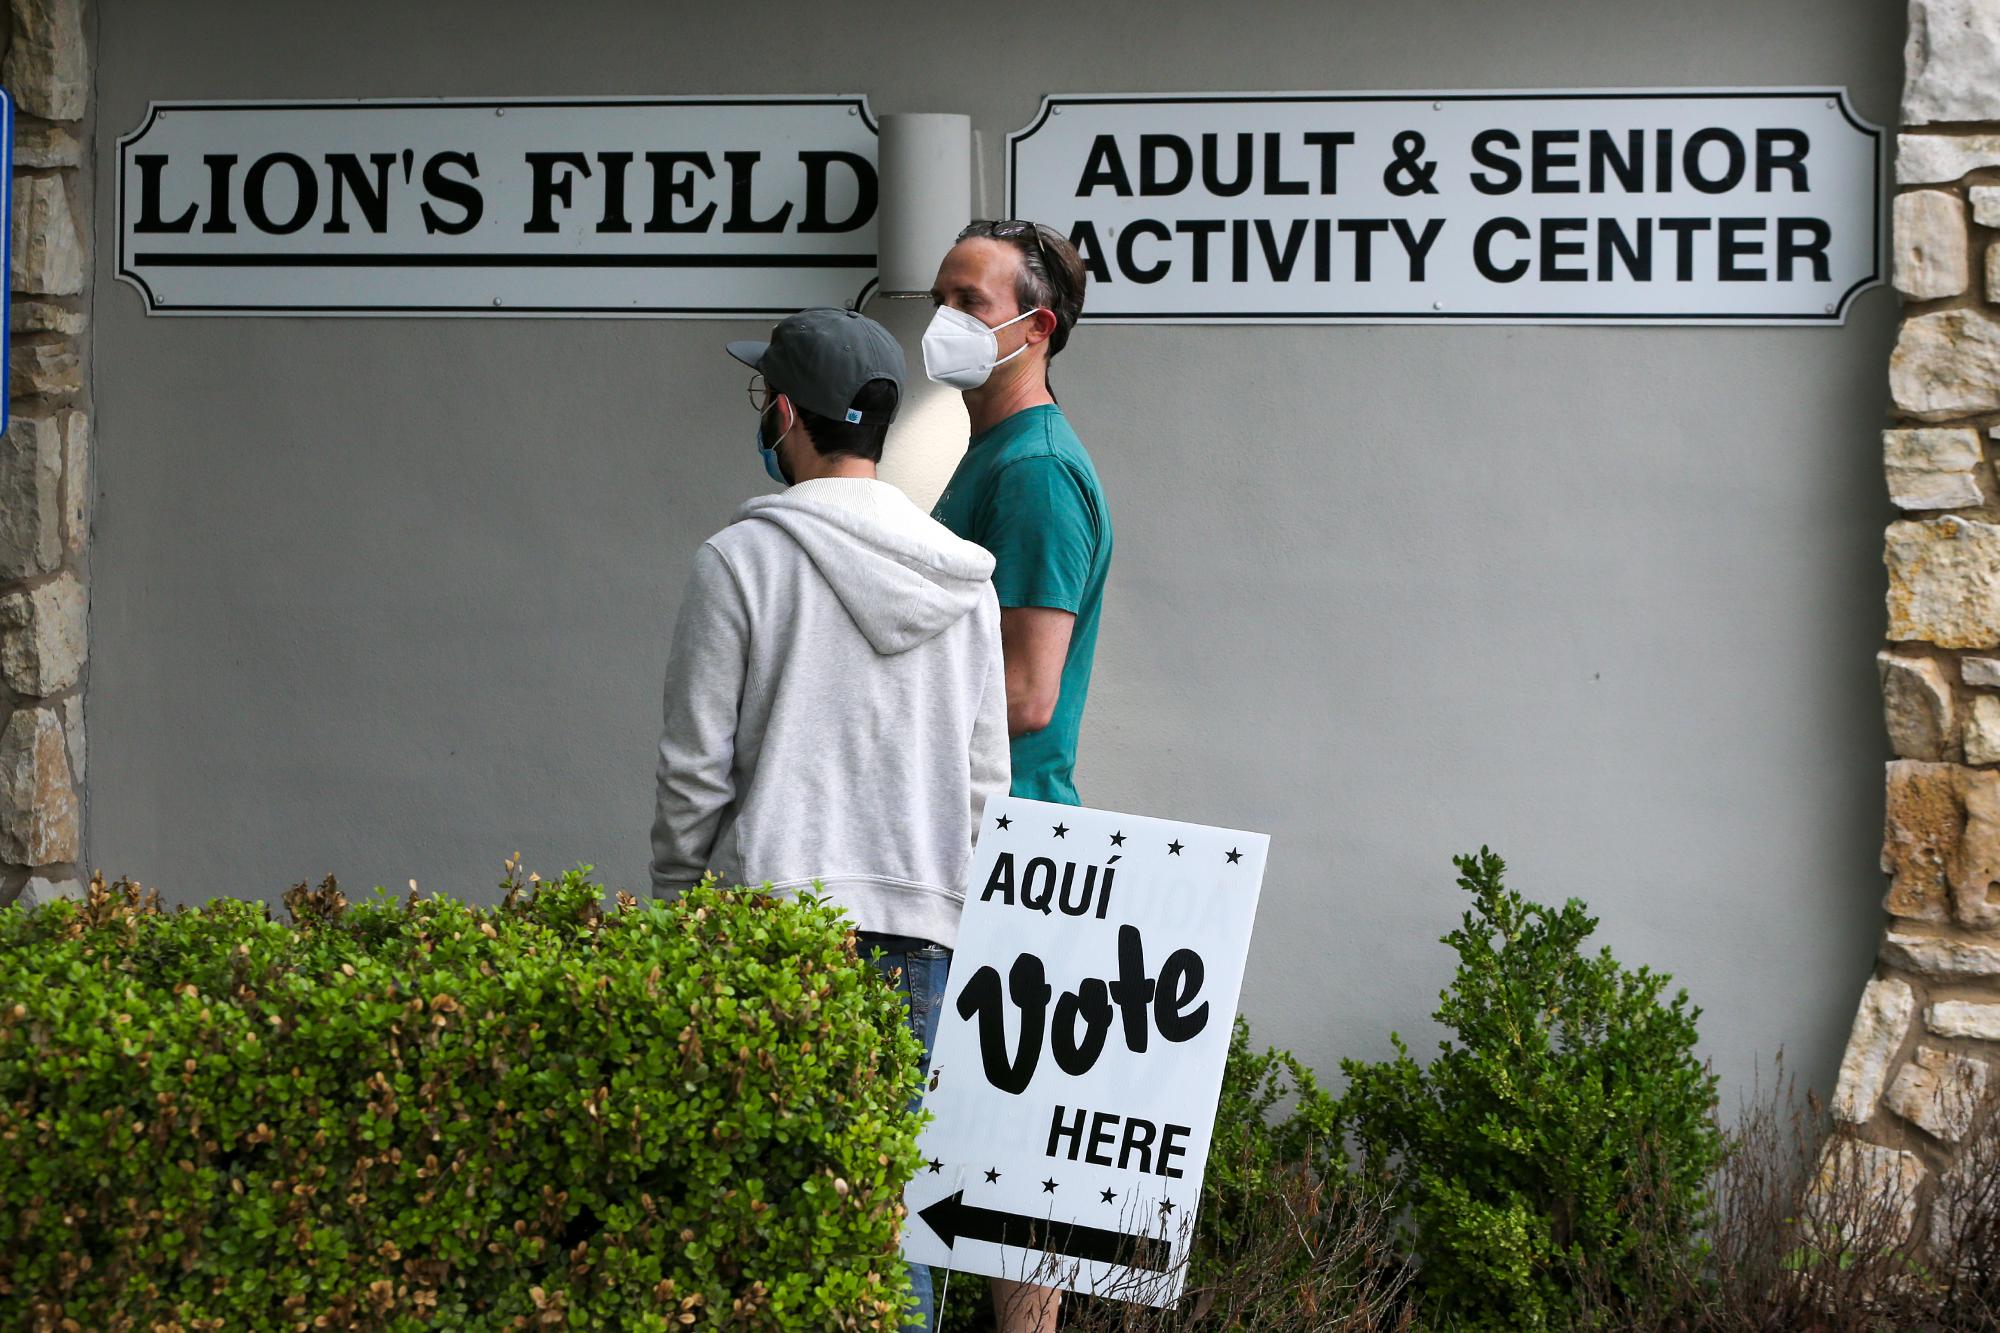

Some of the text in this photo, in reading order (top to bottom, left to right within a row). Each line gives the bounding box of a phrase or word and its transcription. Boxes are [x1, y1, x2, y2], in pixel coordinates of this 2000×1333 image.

[133, 148, 879, 235] LION'S FIELD
[1074, 127, 1811, 198] ADULT & SENIOR
[1069, 216, 1832, 285] ACTIVITY CENTER
[980, 852, 1122, 919] AQUÍ
[956, 924, 1209, 1095] Vote
[1045, 1105, 1192, 1179] HERE
